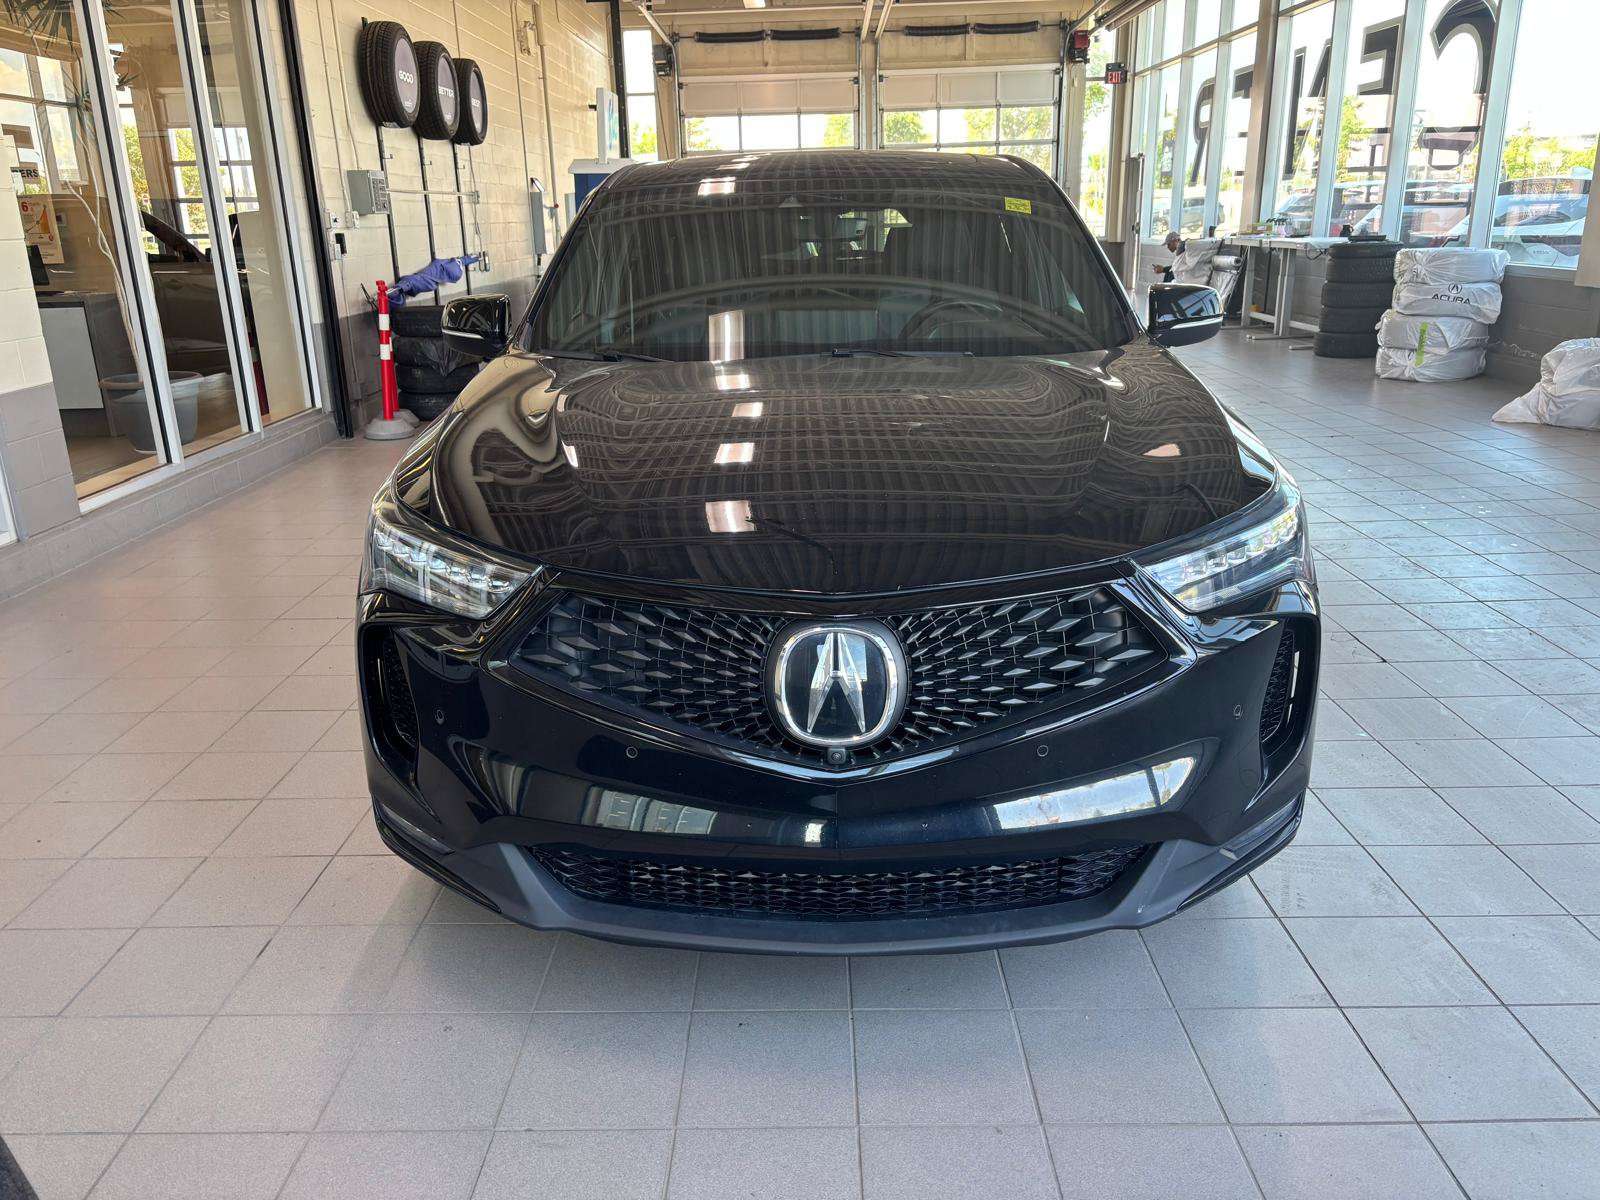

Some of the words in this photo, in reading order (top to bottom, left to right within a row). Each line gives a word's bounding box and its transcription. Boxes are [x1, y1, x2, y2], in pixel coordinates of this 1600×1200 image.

[398, 70, 414, 84] GOOD
[1108, 71, 1121, 83] EXIT
[438, 86, 455, 98] BETTER
[1431, 293, 1471, 306] ACURA
